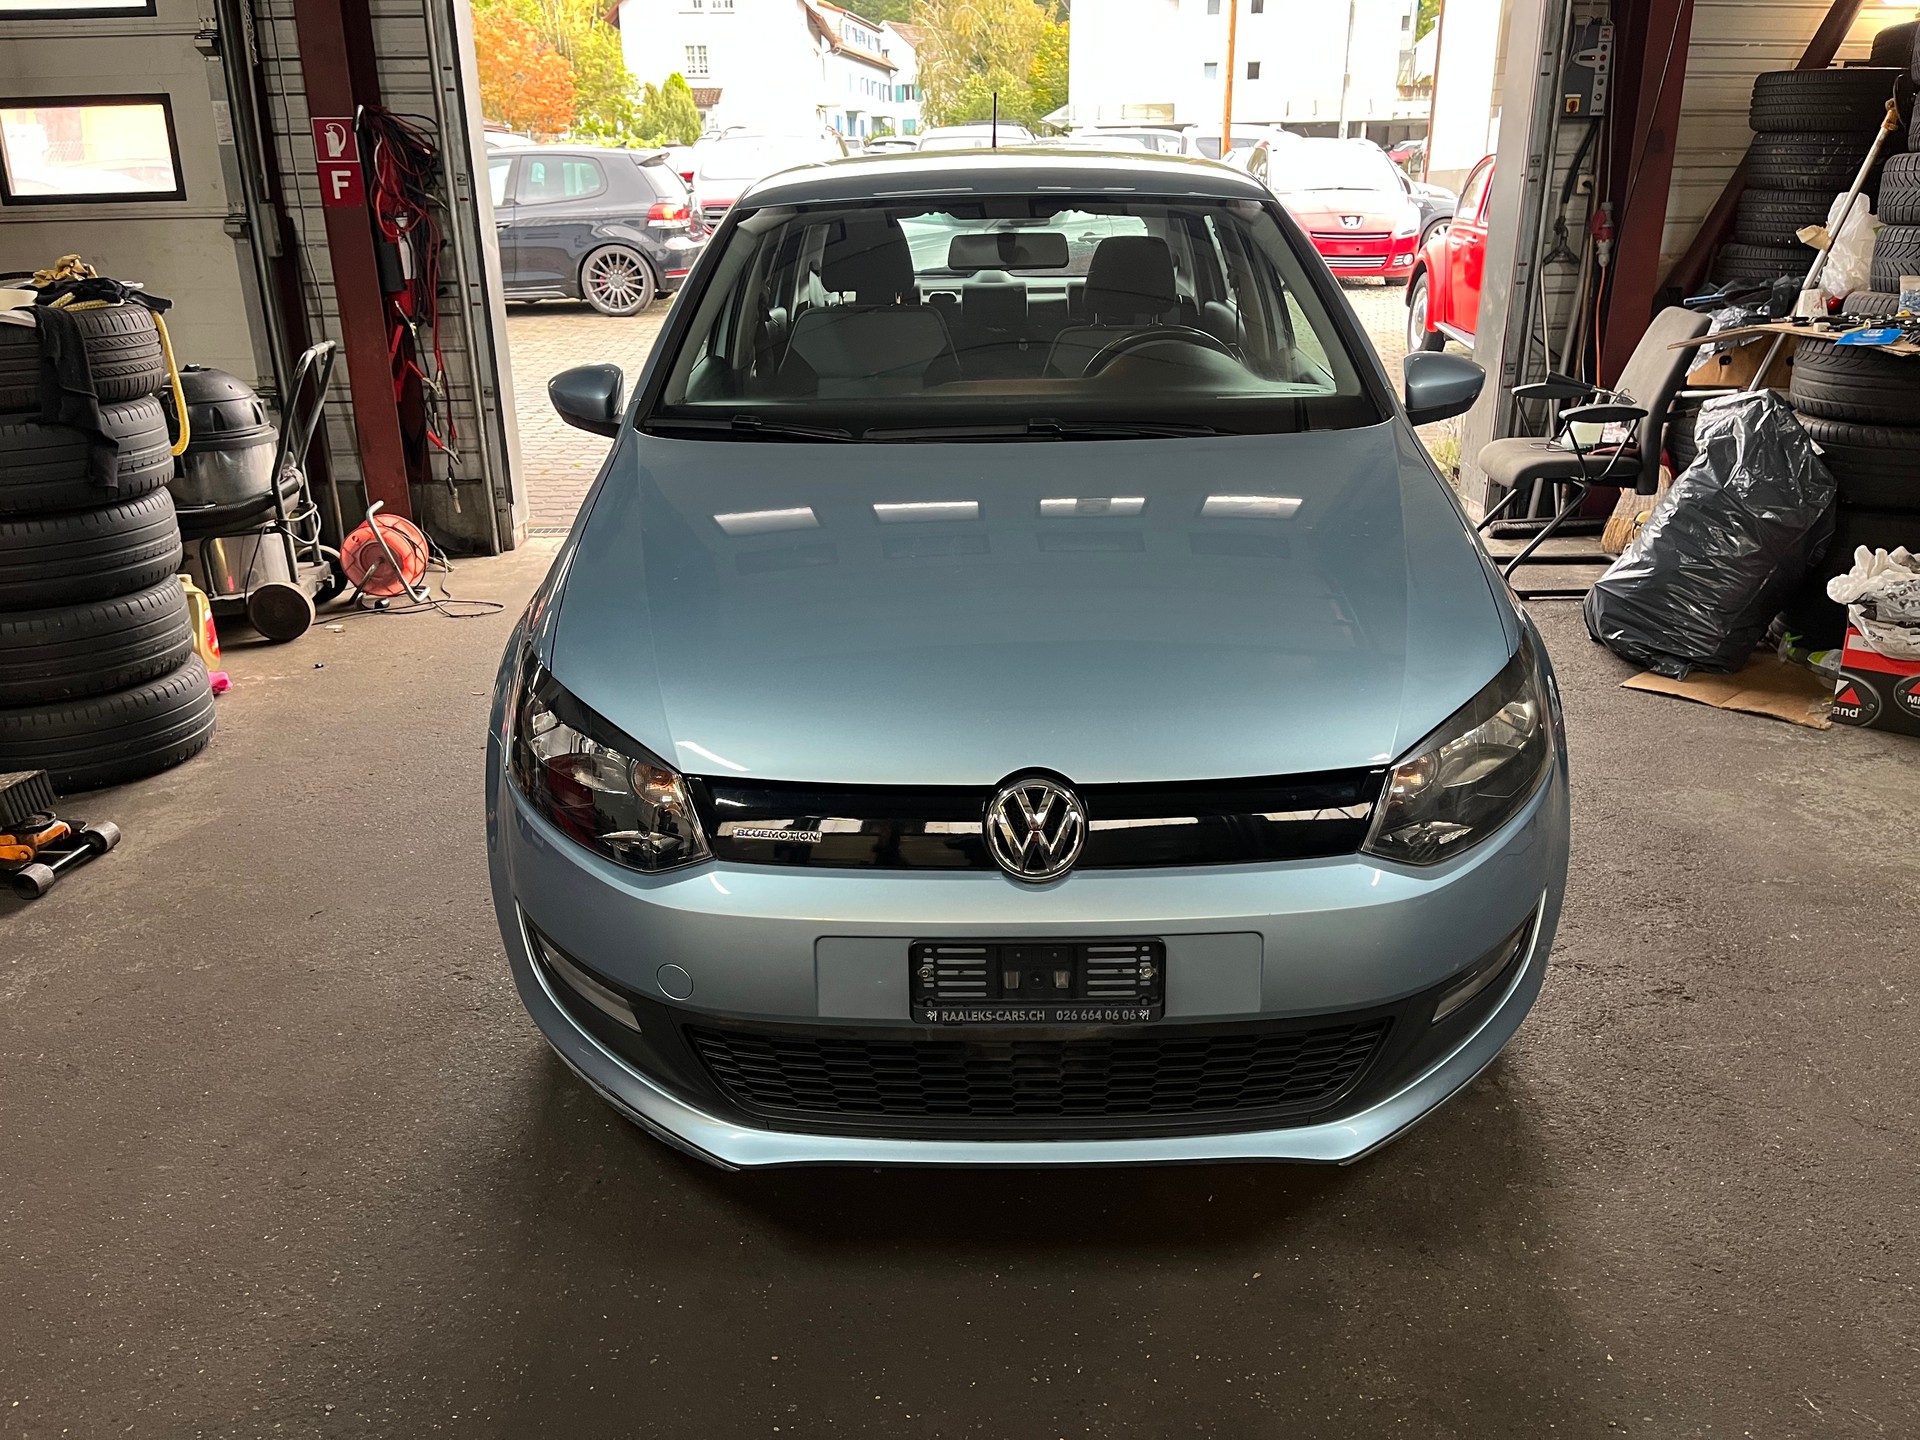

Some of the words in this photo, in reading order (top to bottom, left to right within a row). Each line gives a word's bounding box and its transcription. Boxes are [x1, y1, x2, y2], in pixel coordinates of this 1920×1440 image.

[331, 170, 352, 200] F
[734, 828, 821, 842] BLUEMOTION
[941, 1010, 1046, 1022] RAALEKS-CARS.CH
[1055, 1010, 1078, 1021] 026
[1080, 1010, 1103, 1021] 664
[1104, 1010, 1120, 1021] 06
[1121, 1010, 1137, 1021] 06
